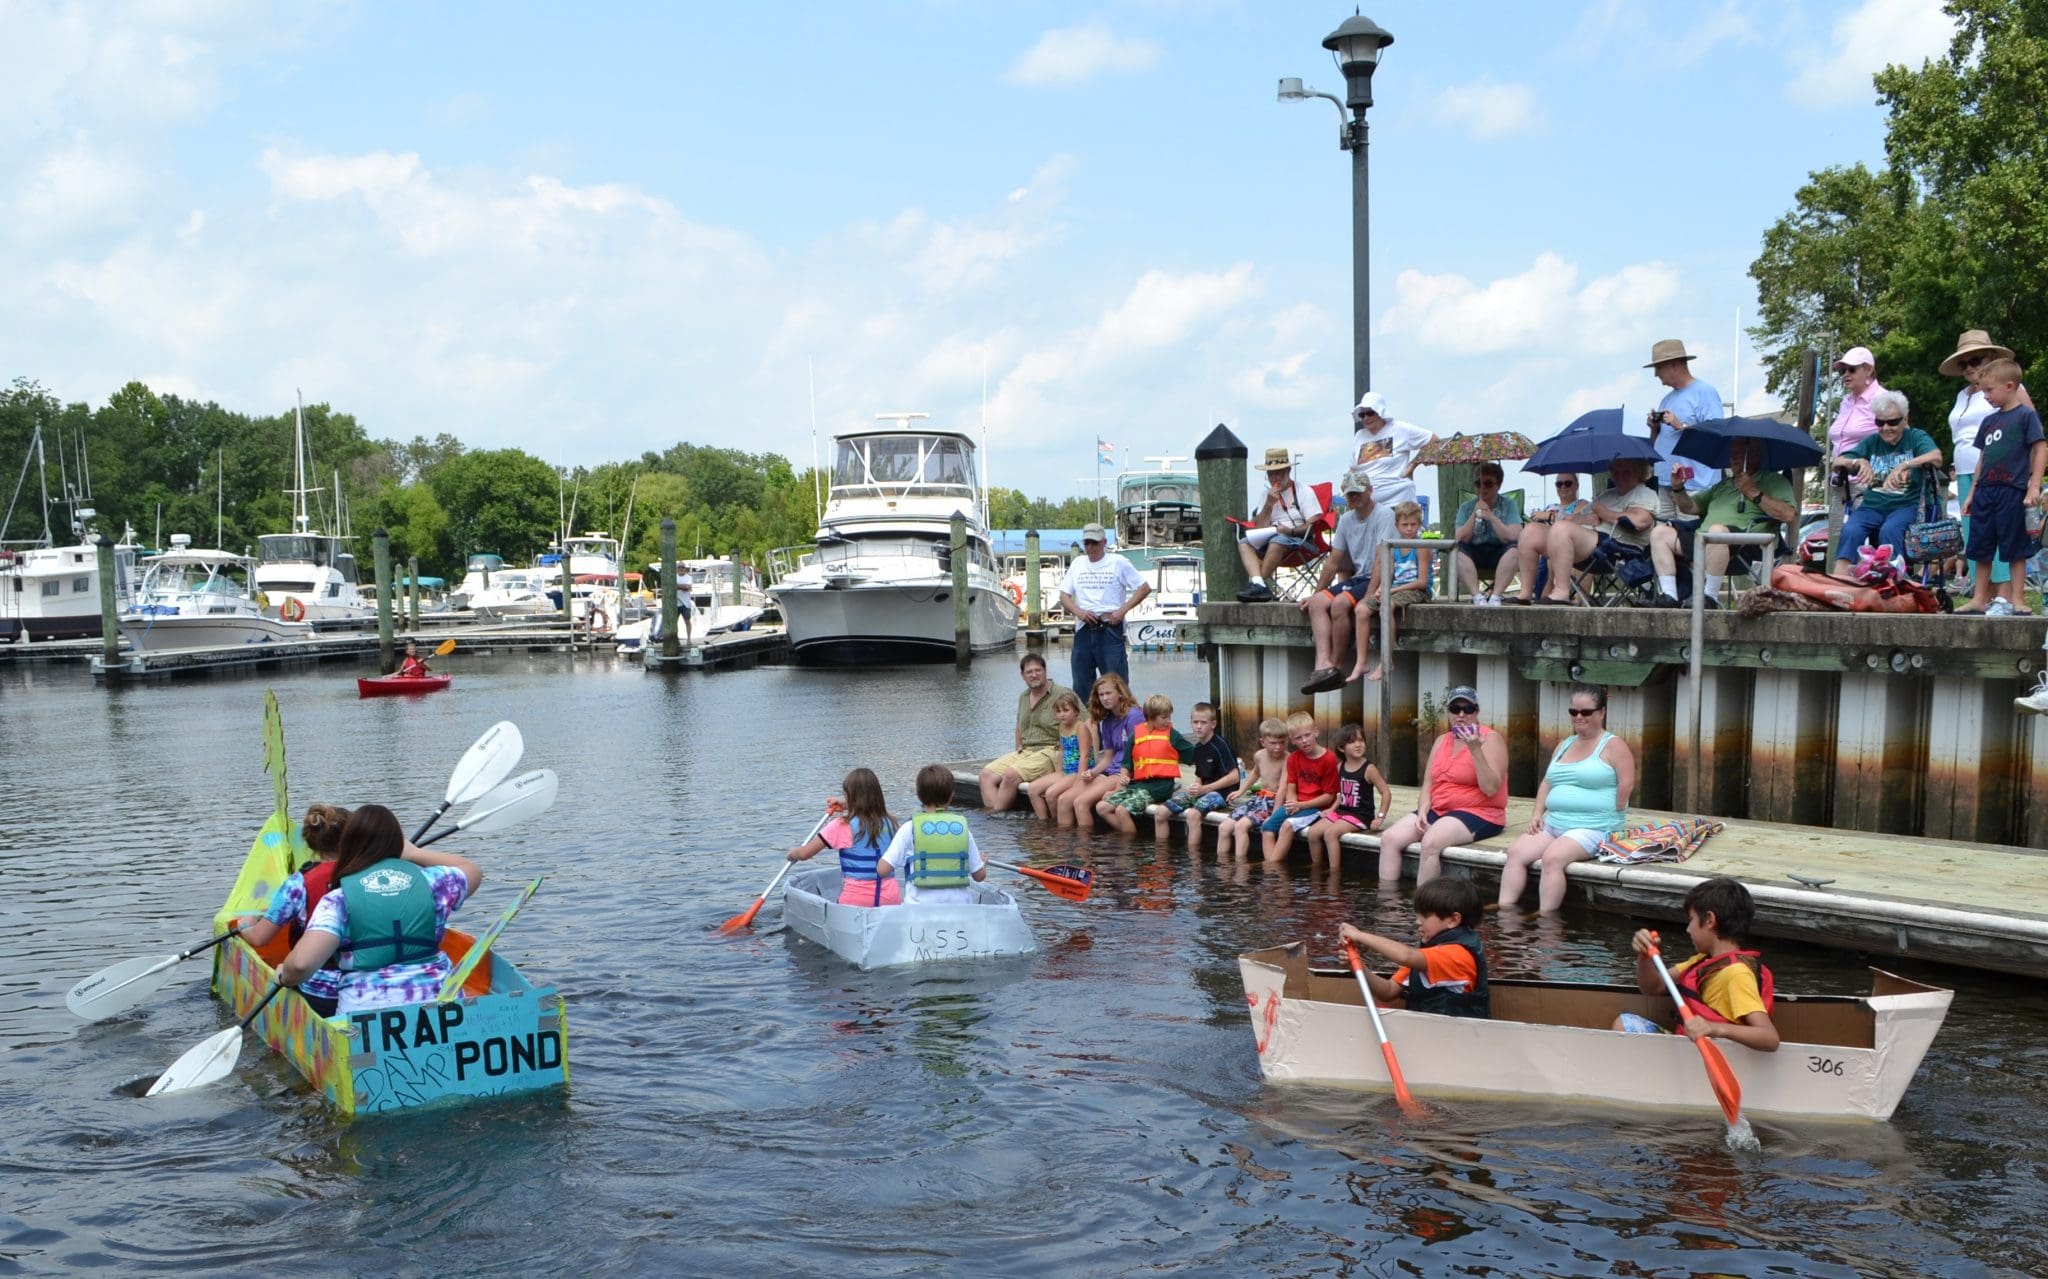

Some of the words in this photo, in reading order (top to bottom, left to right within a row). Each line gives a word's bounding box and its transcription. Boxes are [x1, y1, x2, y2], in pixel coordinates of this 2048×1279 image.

[1340, 781, 1360, 796] WE
[1340, 795, 1361, 807] OME
[909, 926, 969, 950] USS
[352, 1001, 464, 1053] TRAP
[455, 1030, 562, 1081] POND
[1807, 1056, 1845, 1076] 306
[353, 1048, 419, 1111] DAY
